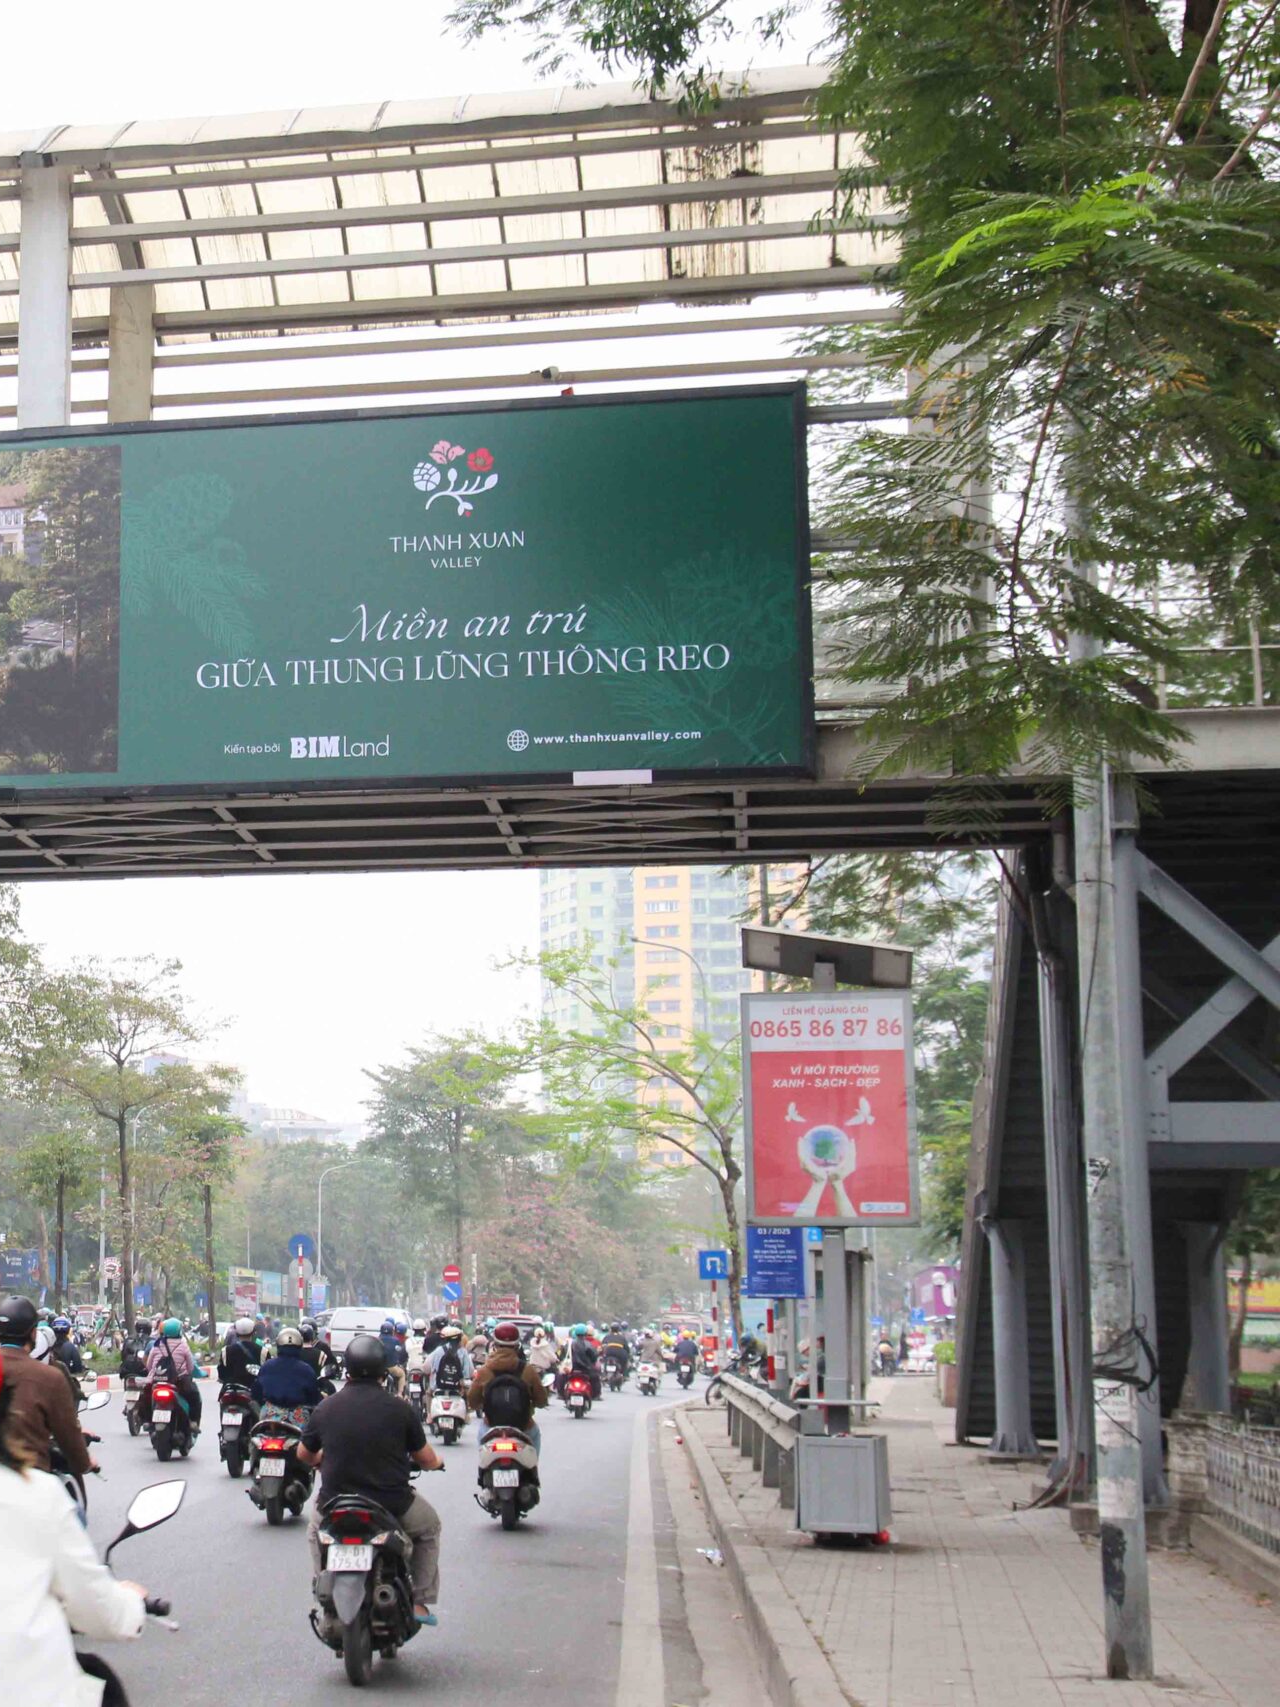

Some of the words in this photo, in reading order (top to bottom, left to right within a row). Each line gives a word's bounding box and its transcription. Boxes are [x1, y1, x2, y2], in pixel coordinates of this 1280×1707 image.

[389, 533, 462, 553] THANH
[468, 530, 525, 549] XUAN
[430, 556, 482, 569] VALLEY
[330, 603, 448, 643] Miền
[463, 613, 511, 638] an
[525, 603, 587, 635] trú
[195, 658, 278, 689] GIỮA
[285, 655, 405, 686] THUNG
[413, 650, 509, 680] LŨNG
[519, 643, 647, 677] THÔNG
[657, 642, 731, 672] REO
[223, 743, 246, 755] Kiến
[247, 745, 263, 756] tạo
[264, 743, 281, 753] bởi
[290, 736, 341, 758] BIM
[343, 734, 390, 758] Land
[533, 730, 702, 745] www.thanhxuanvalley.com
[750, 1020, 802, 1038] 0865
[809, 1019, 835, 1037] 86
[842, 1019, 868, 1037] 87
[876, 1018, 902, 1036] 86
[772, 1078, 805, 1089] XANH
